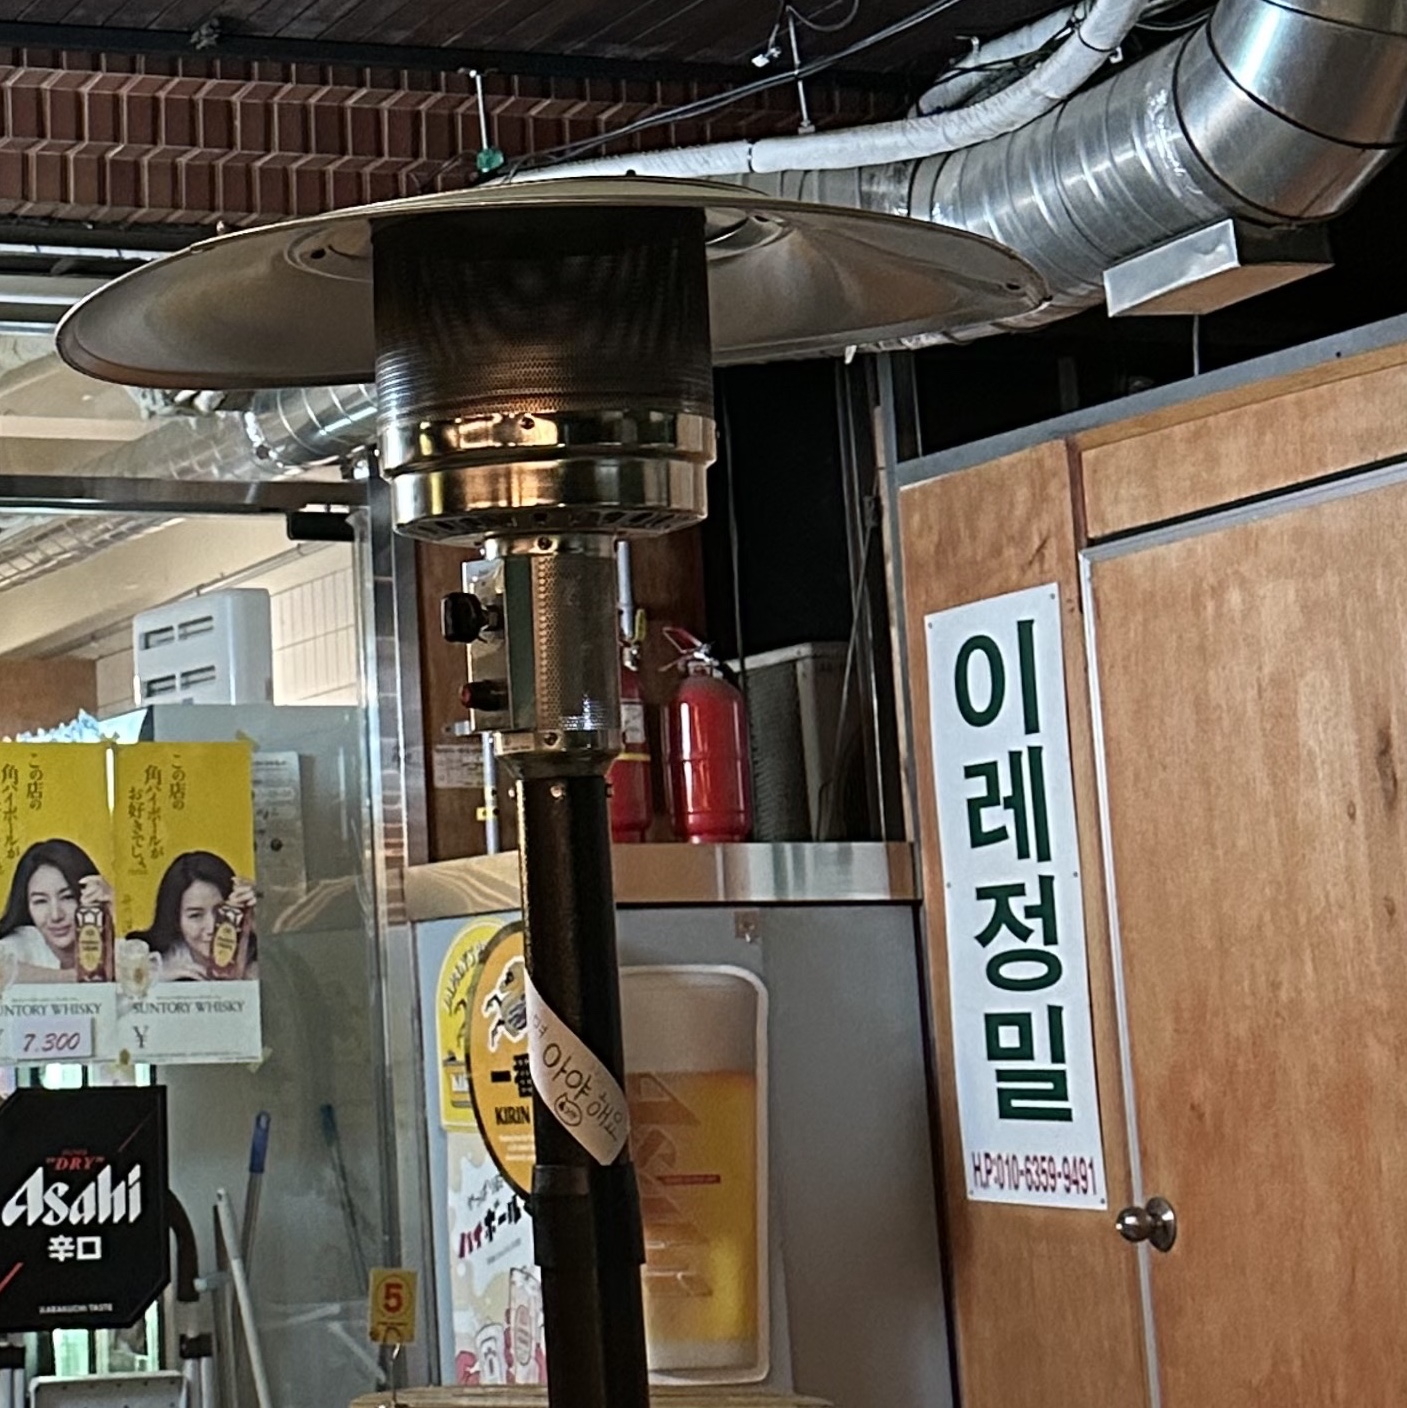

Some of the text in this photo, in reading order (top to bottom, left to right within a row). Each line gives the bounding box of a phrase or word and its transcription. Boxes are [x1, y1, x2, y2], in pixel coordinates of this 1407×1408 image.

[27, 753, 44, 811] この店の
[169, 754, 186, 811] この店の
[1, 763, 20, 859] 角ハイボールが
[954, 618, 1073, 1122] 이레정밀
[51, 1003, 102, 1015] WHISKY
[133, 1001, 245, 1014] SUNTORY WHISKY
[494, 1106, 530, 1125] KIRIN
[1, 1163, 141, 1227] Asahi
[48, 1235, 103, 1262] 辛口
[384, 1283, 403, 1313] 5
